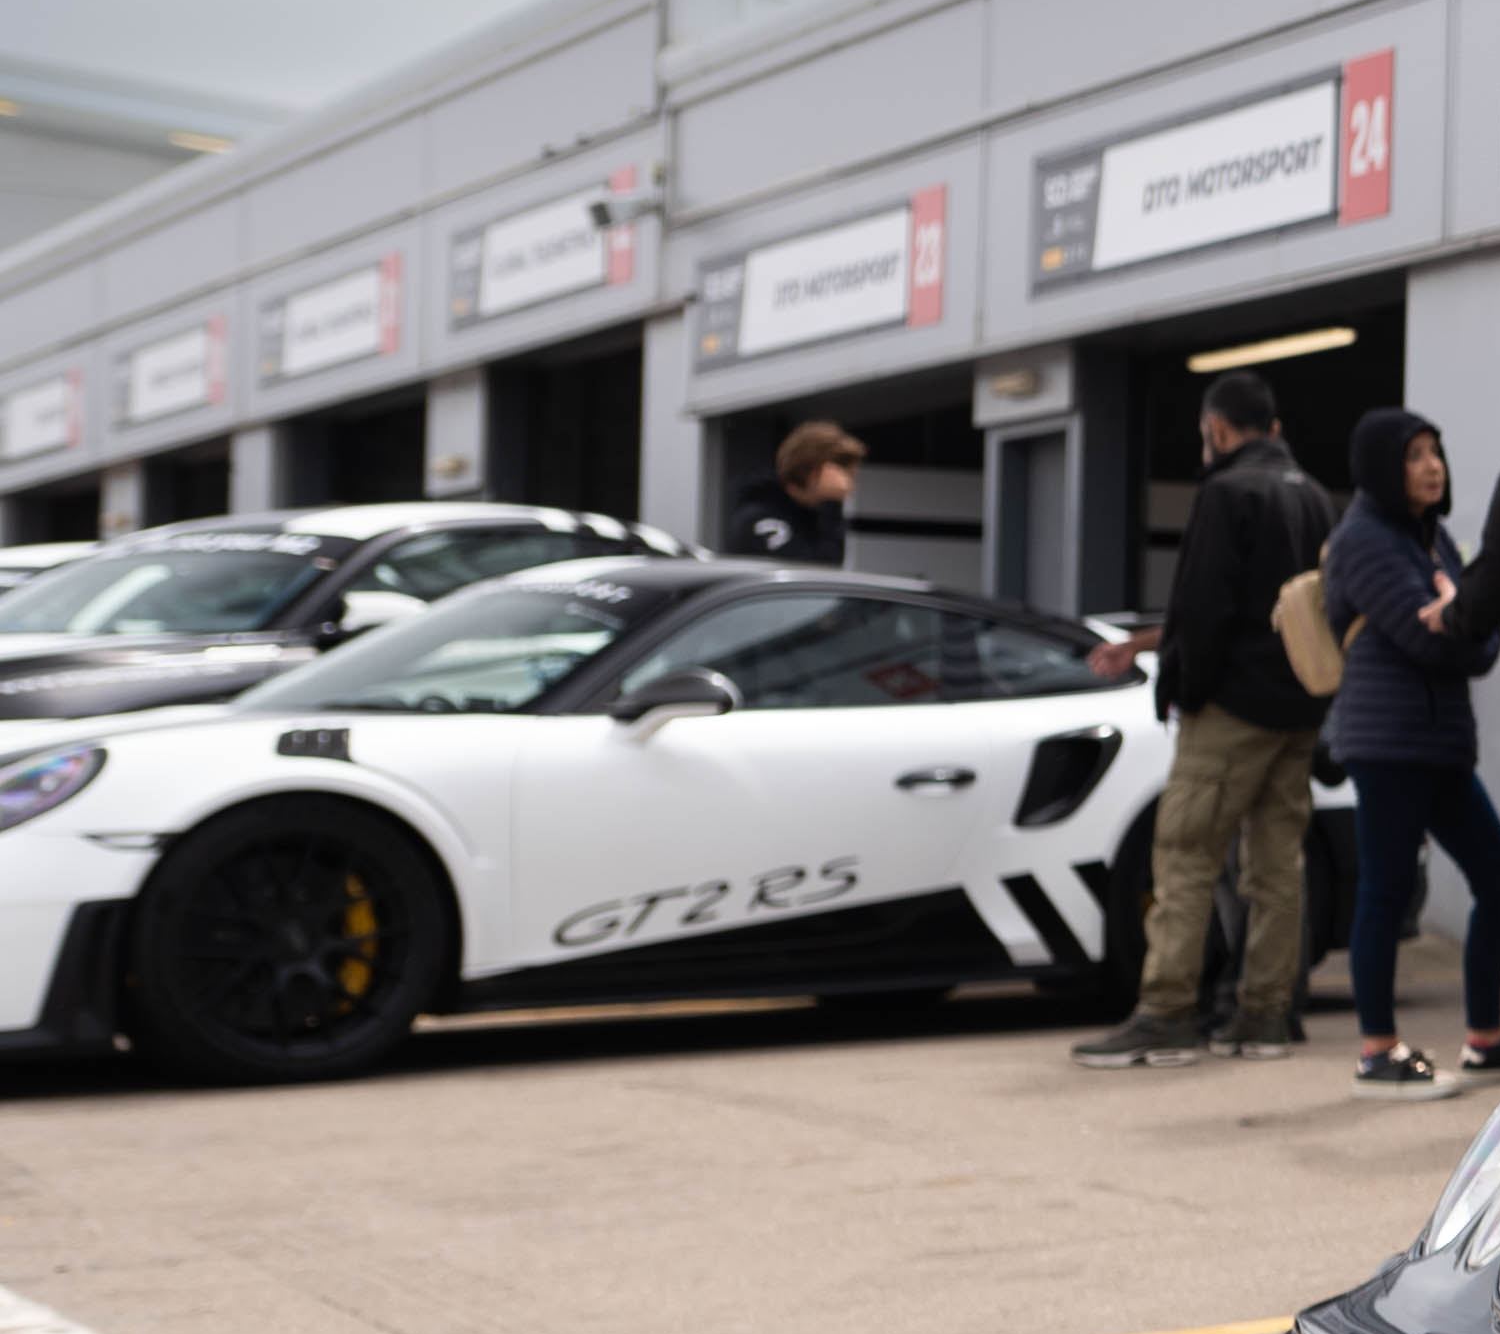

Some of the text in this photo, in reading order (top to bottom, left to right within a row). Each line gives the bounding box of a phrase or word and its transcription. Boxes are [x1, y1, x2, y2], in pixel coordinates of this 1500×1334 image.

[1185, 134, 1324, 202] MOTORSPORT
[1349, 94, 1388, 177] 24
[914, 222, 942, 289] 23
[551, 856, 860, 949] GT2 RS
